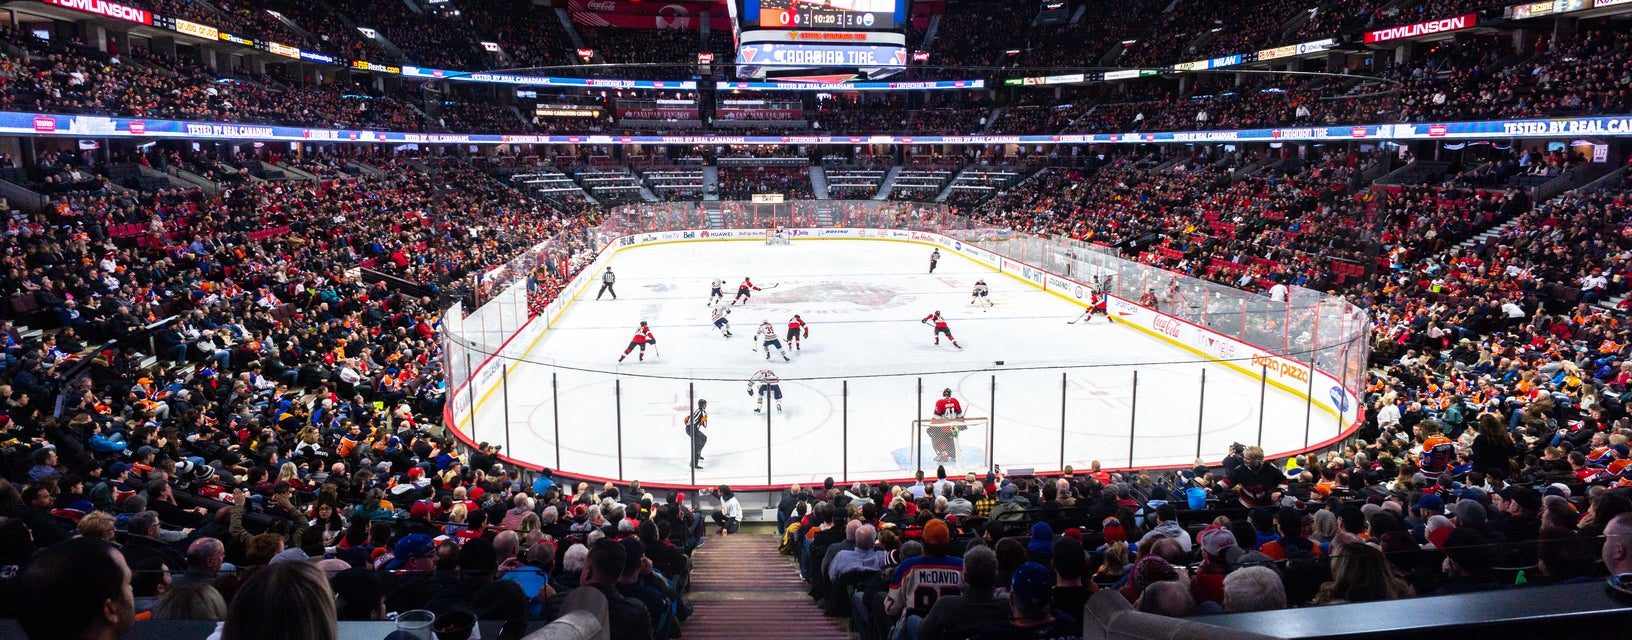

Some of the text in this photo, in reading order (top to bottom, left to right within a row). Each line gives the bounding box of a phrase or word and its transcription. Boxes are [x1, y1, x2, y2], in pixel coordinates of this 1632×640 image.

[813, 15, 835, 24] 10:20
[1373, 17, 1464, 42] TOMLINSON
[781, 50, 874, 65] CANADIAN TIRE
[187, 124, 273, 138] TESTED BY REAL CANADIANS
[1280, 128, 1329, 138] CANADIAN TIRE
[1503, 119, 1632, 134] TESTED BY REAL CA
[683, 231, 695, 239] Bell
[1251, 353, 1308, 384] pizza pizza
[919, 570, 959, 585] McDAVID
